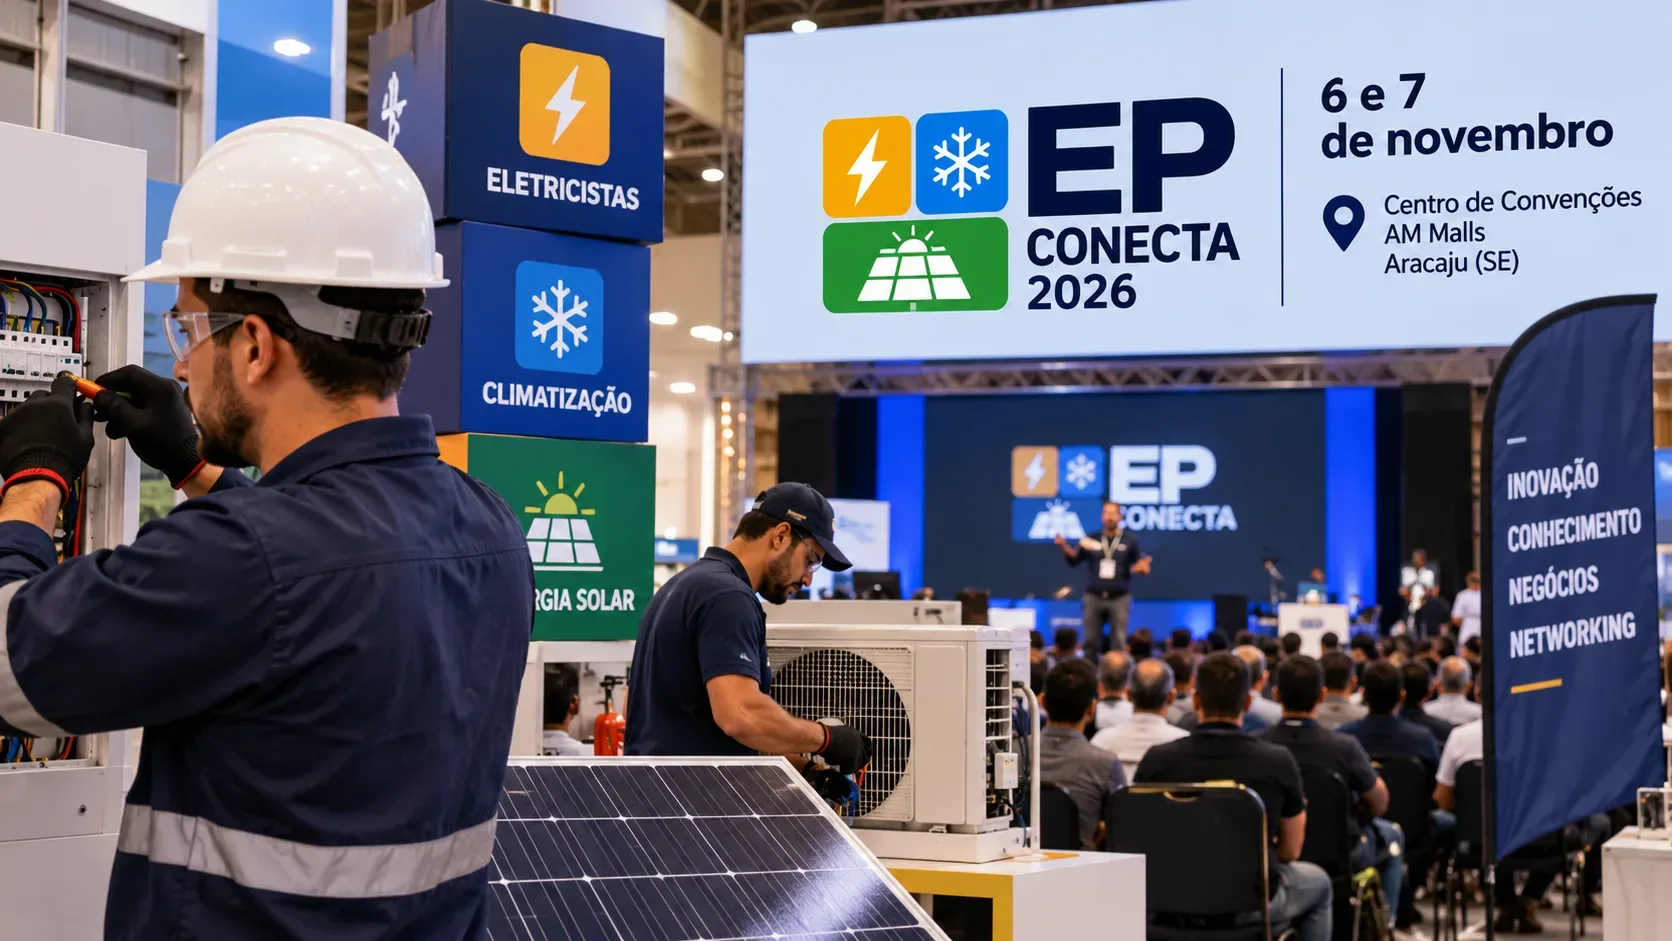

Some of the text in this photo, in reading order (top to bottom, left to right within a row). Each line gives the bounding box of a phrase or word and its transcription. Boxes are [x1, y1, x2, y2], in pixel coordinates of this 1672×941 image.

[1321, 72, 1426, 114] 6 e 7
[1027, 96, 1236, 218] EP
[1321, 111, 1614, 160] de novembro
[487, 166, 640, 211] ELETRICISTAS
[1384, 185, 1643, 216] Centro de Convenções
[1026, 221, 1241, 267] CONECTA
[1383, 220, 1486, 245] AM Malls
[1383, 248, 1520, 278] Aracaju (SE)
[1027, 272, 1137, 310] 2026
[482, 381, 633, 418] CLIMATIZAÇÃO
[1109, 444, 1217, 504] EP
[1507, 457, 1600, 501] INOVAÇÃO
[1507, 507, 1642, 553] CONHECIMENTO
[575, 588, 635, 612] SOLAR
[1508, 564, 1600, 606] NEGÓCIOS
[1509, 611, 1637, 659] NETWORKING
